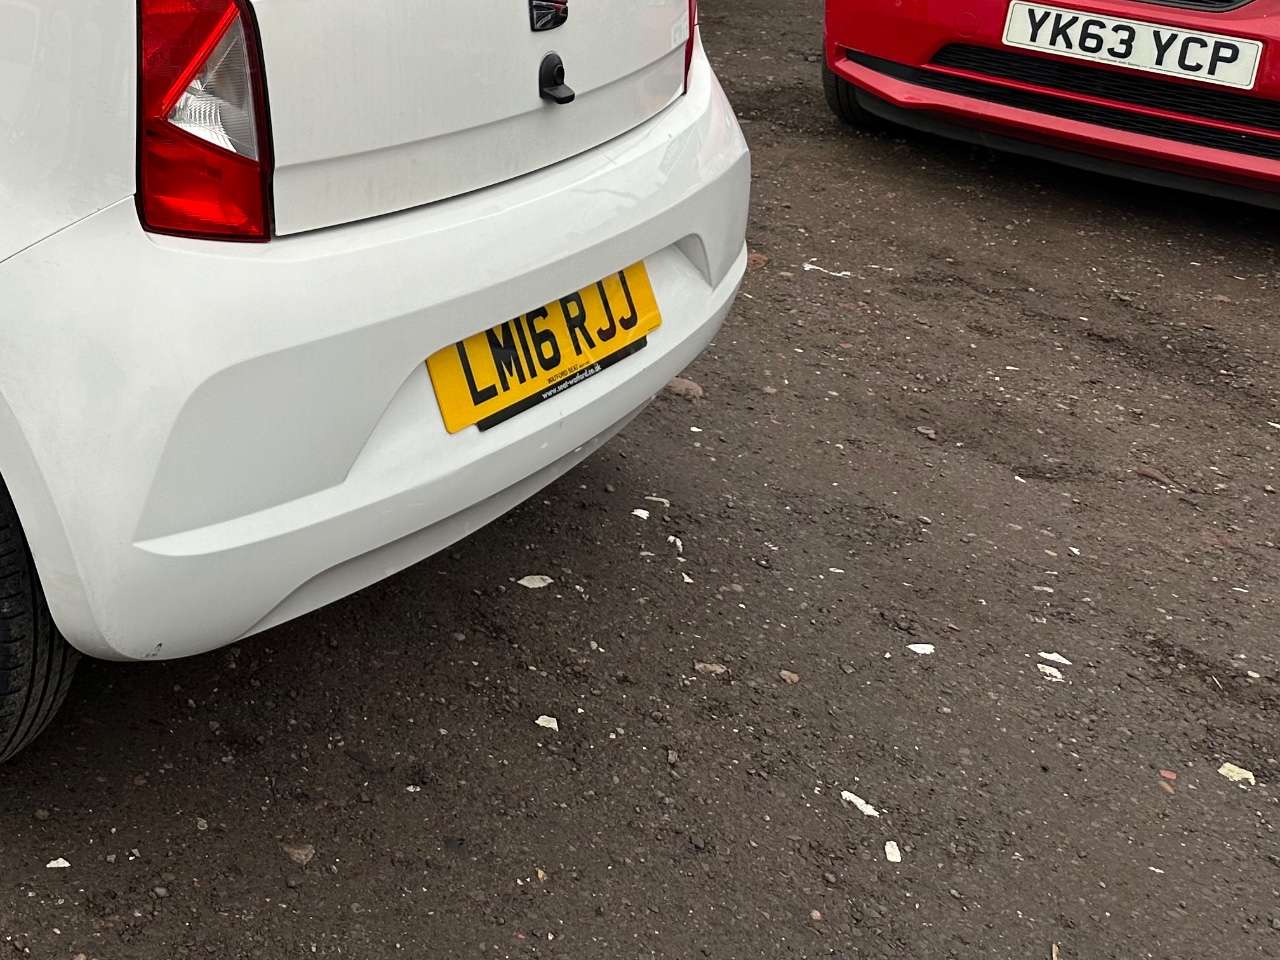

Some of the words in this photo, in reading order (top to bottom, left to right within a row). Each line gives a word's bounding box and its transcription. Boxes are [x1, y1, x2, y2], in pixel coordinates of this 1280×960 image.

[1027, 7, 1136, 60] YK63
[1152, 29, 1241, 76] YCP
[455, 305, 561, 406] LM16
[559, 269, 638, 356] RJJ
